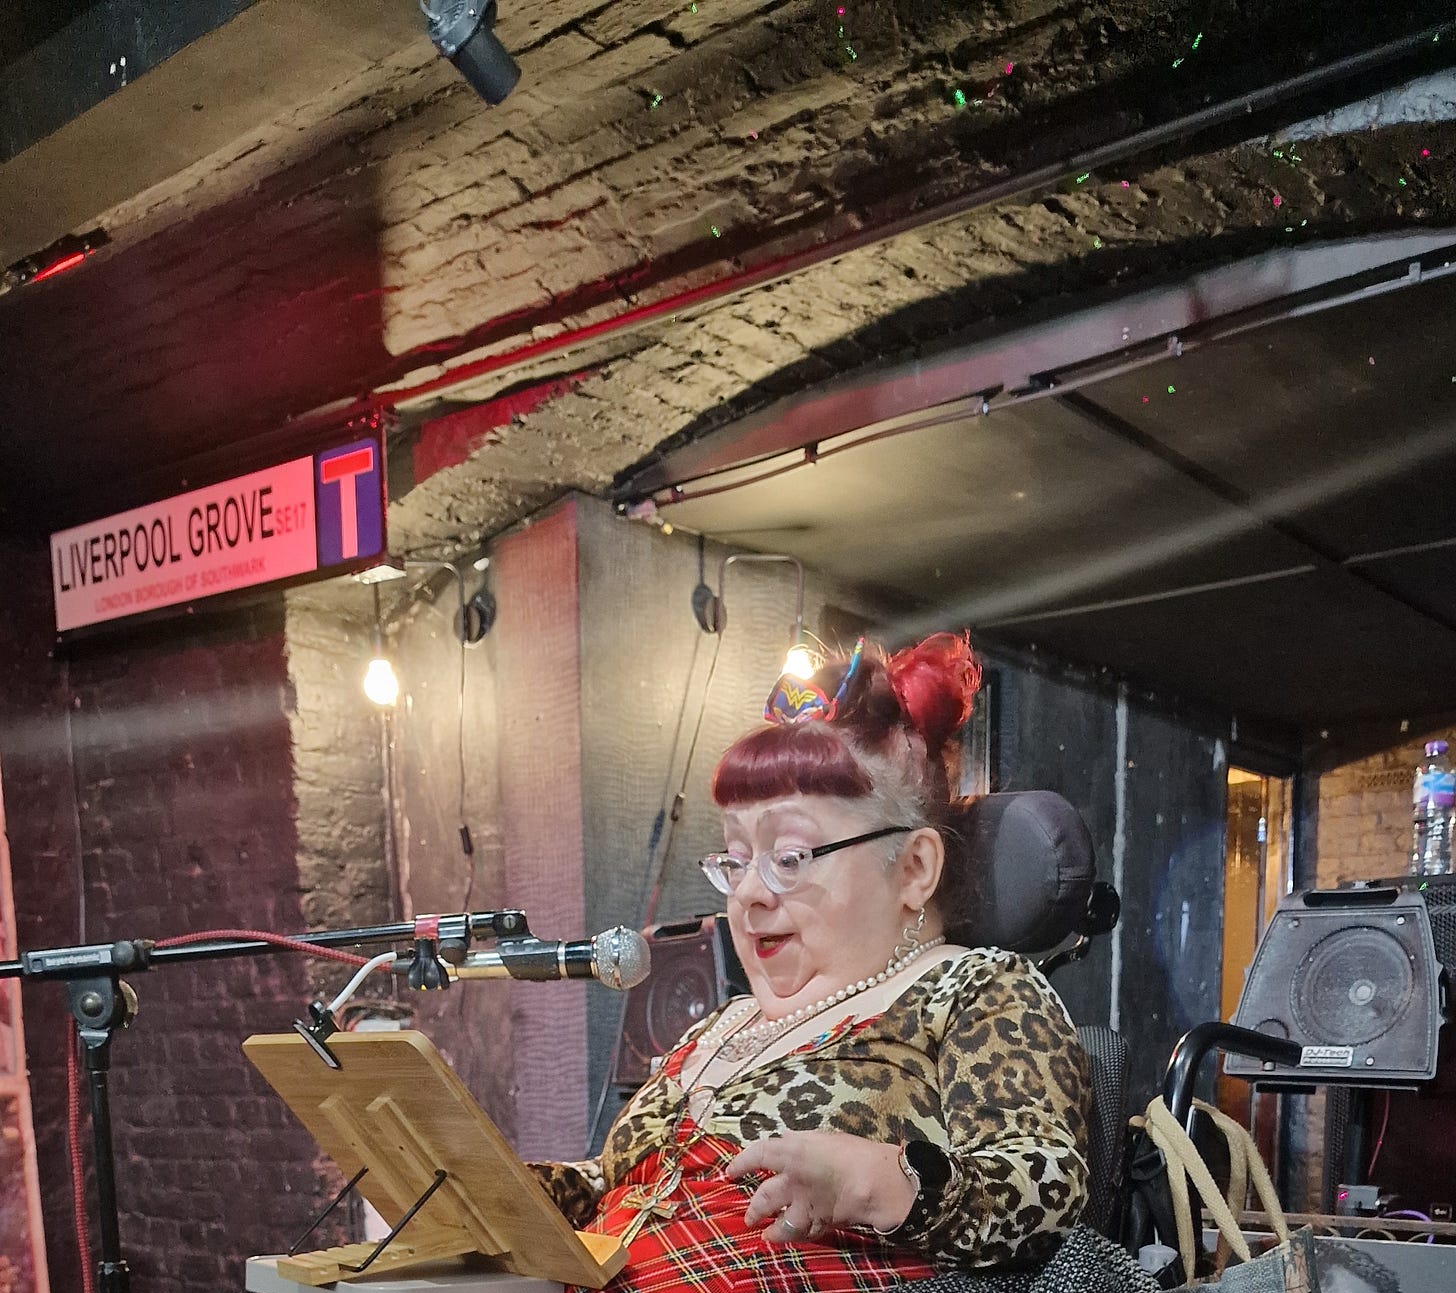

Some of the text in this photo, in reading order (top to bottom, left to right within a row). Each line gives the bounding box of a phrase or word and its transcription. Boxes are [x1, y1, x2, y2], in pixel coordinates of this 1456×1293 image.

[58, 485, 307, 592] LIVERPOOL GROVE SE17
[95, 556, 265, 613] LONDON BOROUGH OF SOUTHWARK
